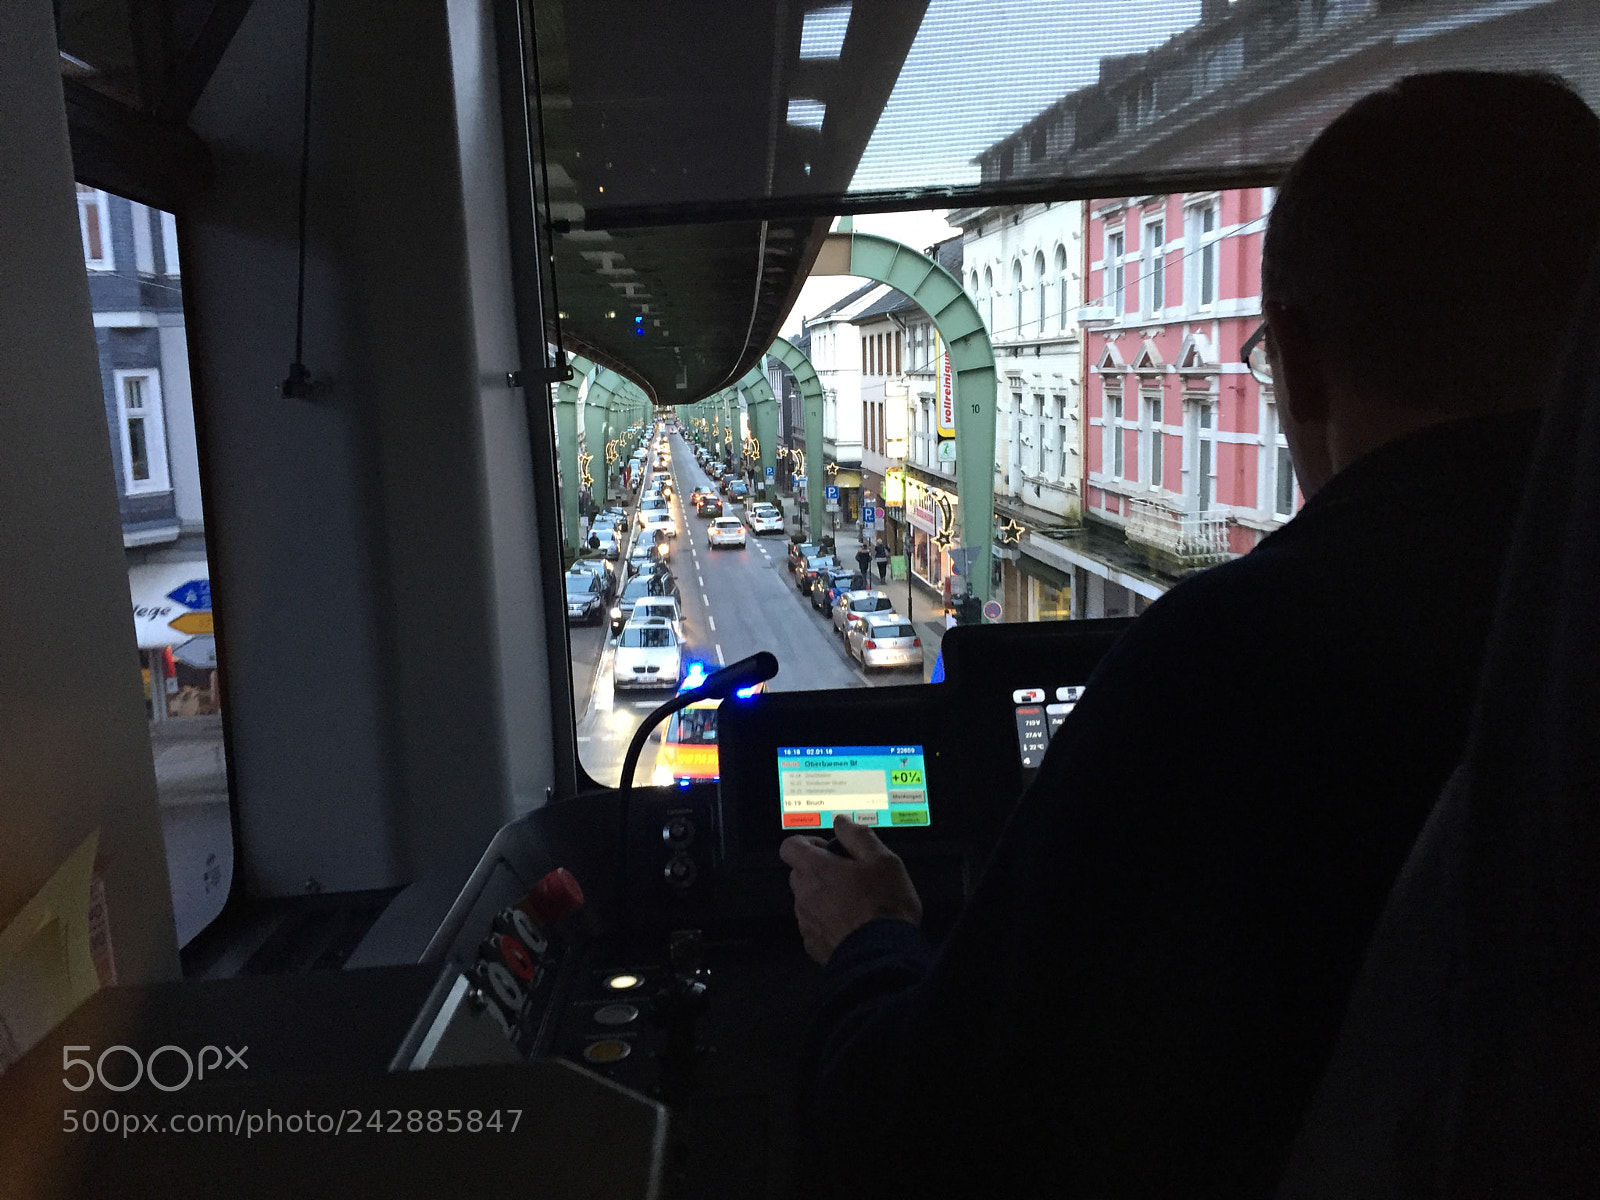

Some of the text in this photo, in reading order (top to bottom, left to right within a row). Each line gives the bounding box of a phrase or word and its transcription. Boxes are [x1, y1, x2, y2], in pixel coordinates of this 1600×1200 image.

[971, 404, 980, 414] 10
[828, 487, 836, 498] P
[865, 508, 873, 521] P
[804, 760, 849, 768] Oberbarmen
